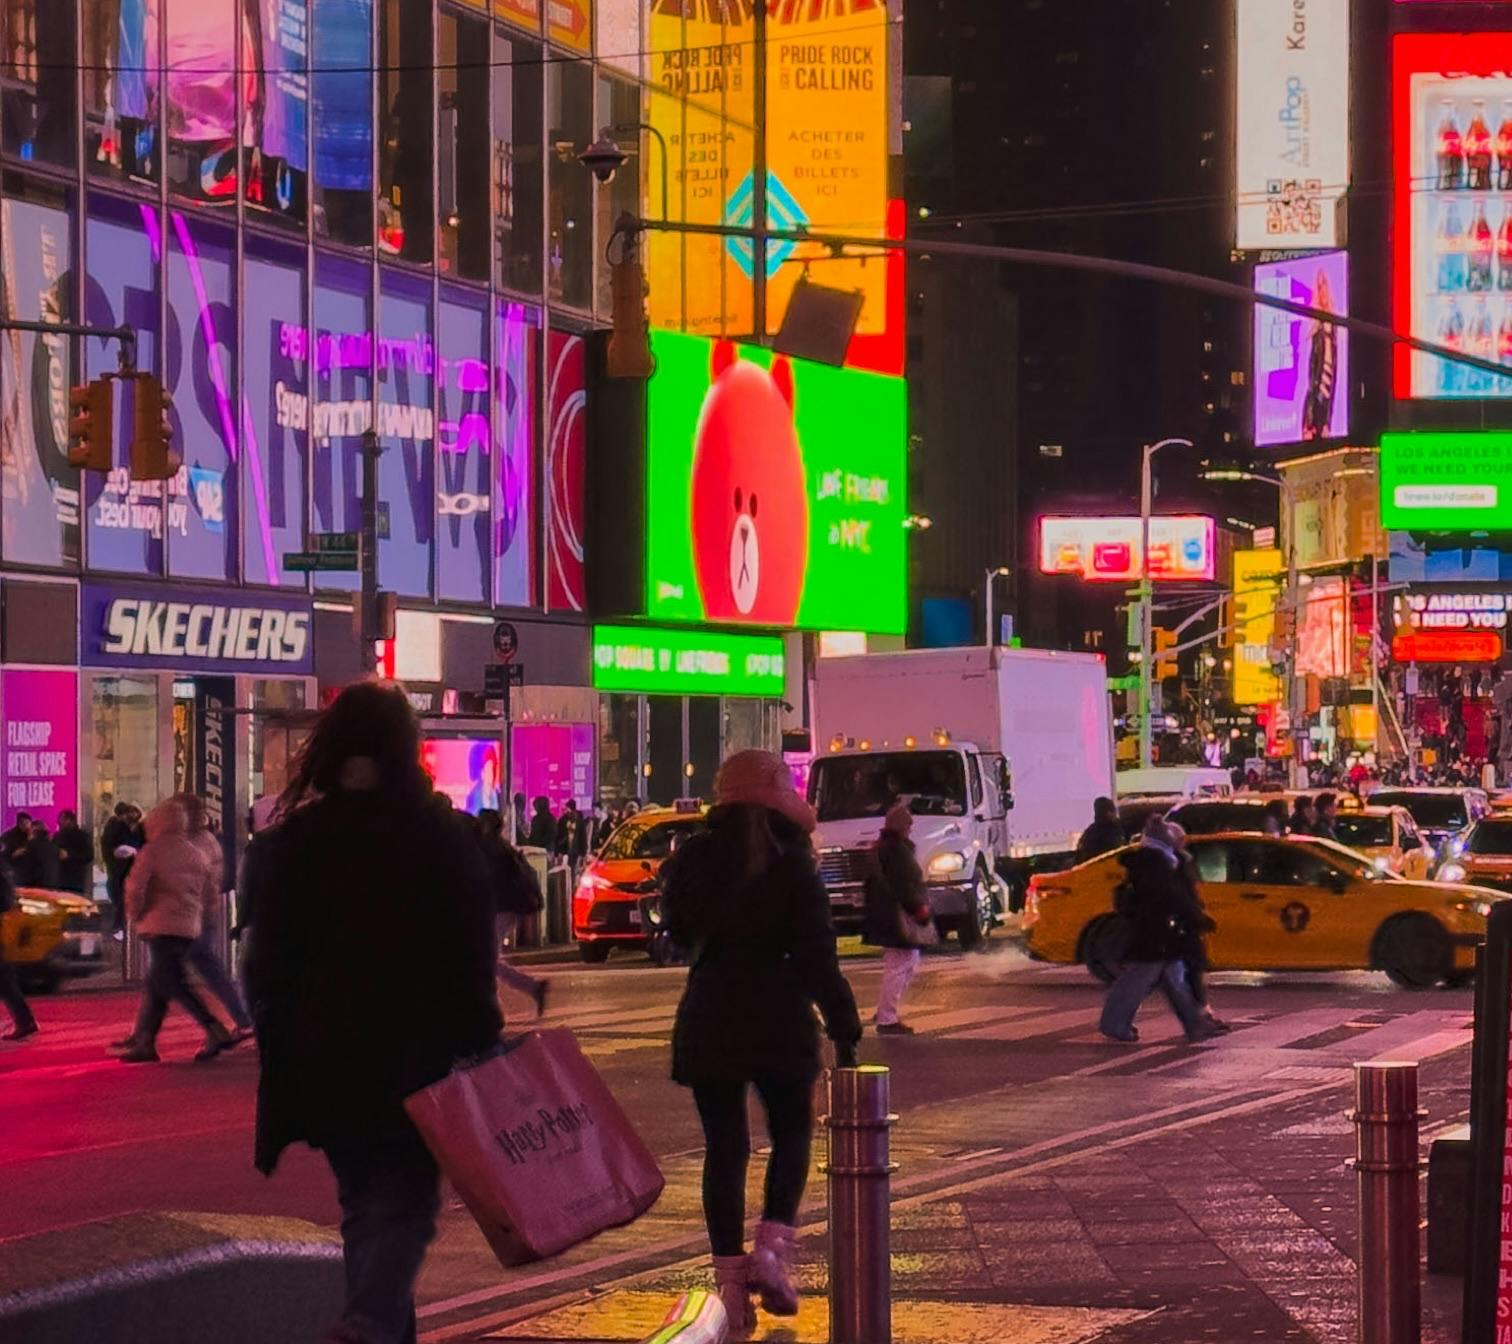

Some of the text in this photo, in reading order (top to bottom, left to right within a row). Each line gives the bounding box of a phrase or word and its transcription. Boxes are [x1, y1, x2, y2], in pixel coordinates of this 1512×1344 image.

[781, 46, 873, 65] PRIDE ROCK
[796, 68, 873, 90] CALLING
[788, 131, 864, 142] ACHETER
[811, 149, 842, 161] DES
[794, 167, 859, 178] BILLETS
[816, 185, 837, 195] ICI
[1395, 446, 1425, 456] LOS
[1429, 446, 1500, 456] ANGELES
[1395, 463, 1421, 475] WE
[1427, 463, 1466, 475] NEED
[1427, 594, 1504, 611] ANGELES
[1422, 611, 1468, 627] NEED
[105, 598, 309, 661] SKECHERS
[8, 720, 51, 746] FLAGSHIP
[8, 752, 67, 776] RETAIL SPACE
[8, 781, 55, 807] FOR LEASE
